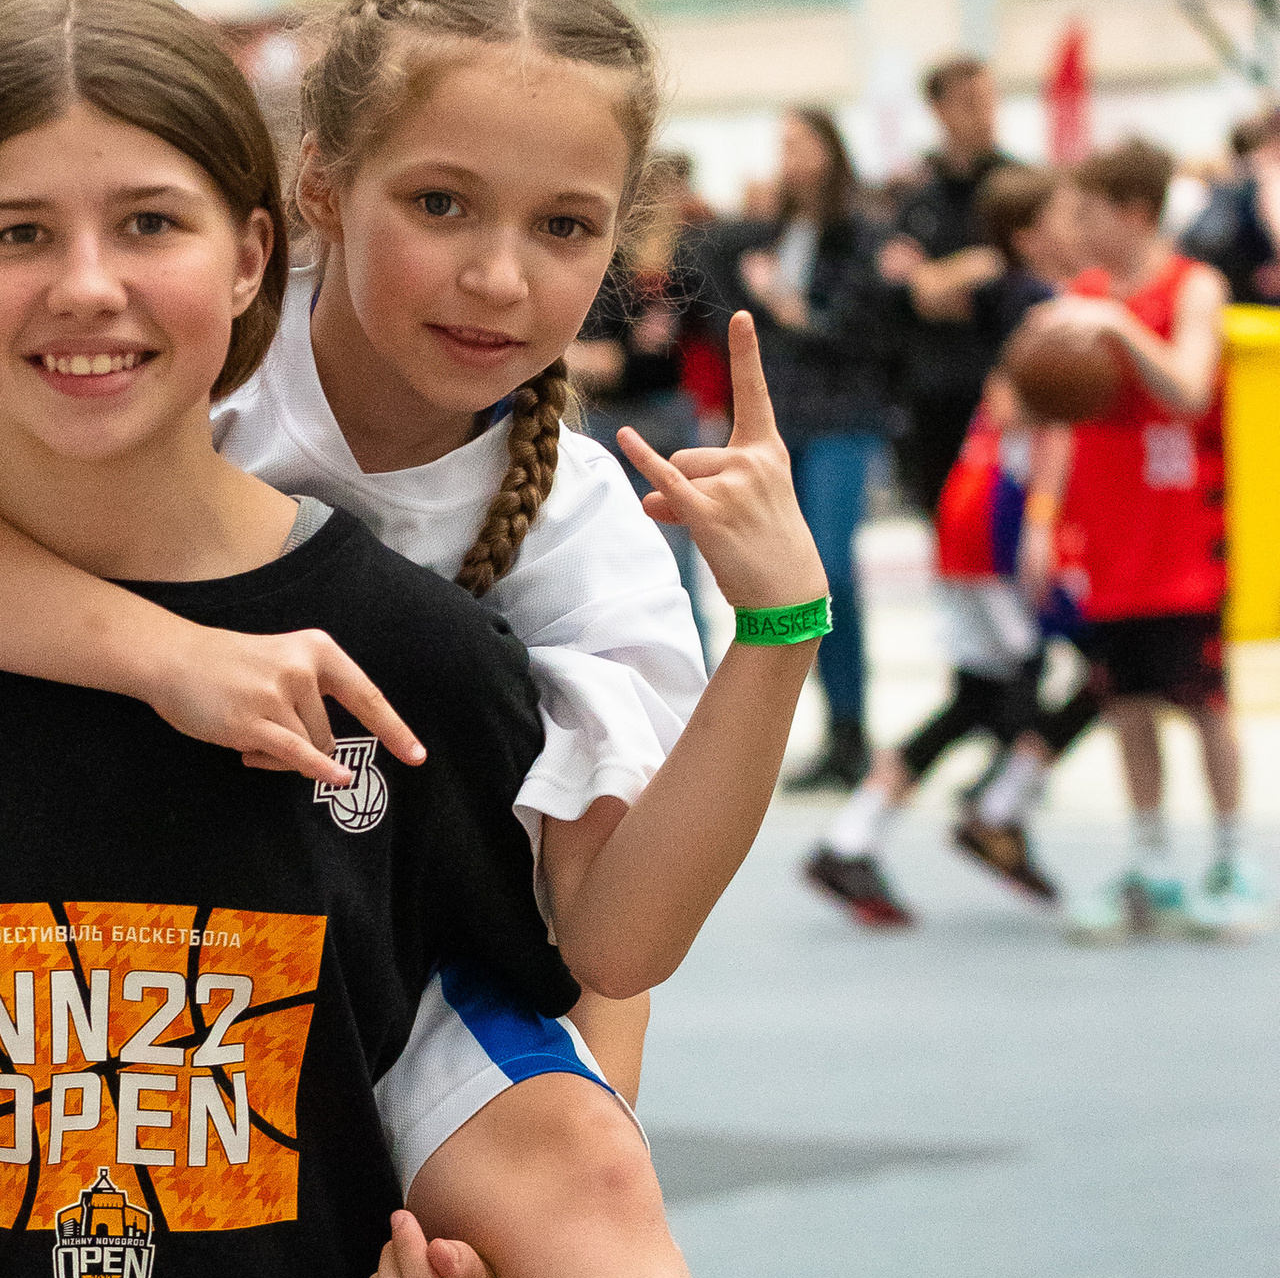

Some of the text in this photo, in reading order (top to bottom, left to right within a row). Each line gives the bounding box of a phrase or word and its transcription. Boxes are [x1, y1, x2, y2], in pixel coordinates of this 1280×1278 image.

[112, 926, 241, 948] БАСКЕТБОЛА
[61, 1237, 145, 1247] NIZHNY NOVGOROD
